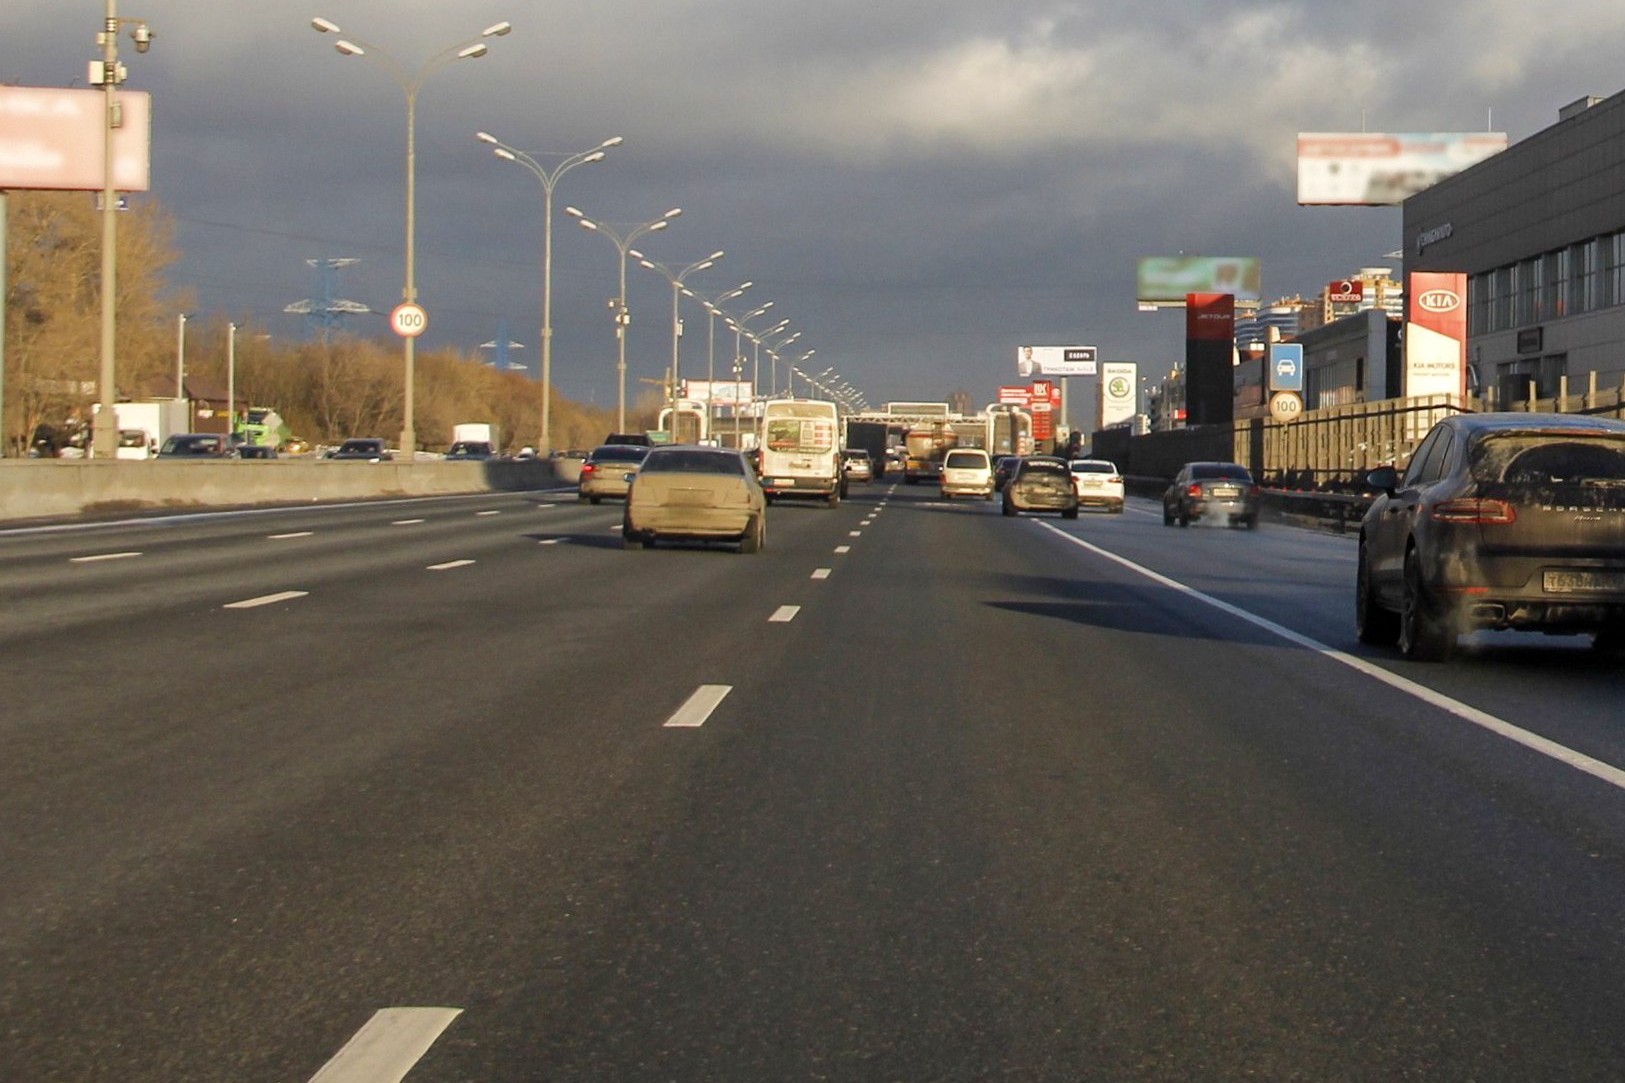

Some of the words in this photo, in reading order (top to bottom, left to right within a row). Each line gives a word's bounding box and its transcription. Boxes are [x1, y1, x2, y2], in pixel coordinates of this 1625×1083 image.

[1425, 294, 1454, 307] KIA
[399, 313, 422, 327] 100
[1275, 400, 1297, 413] 100
